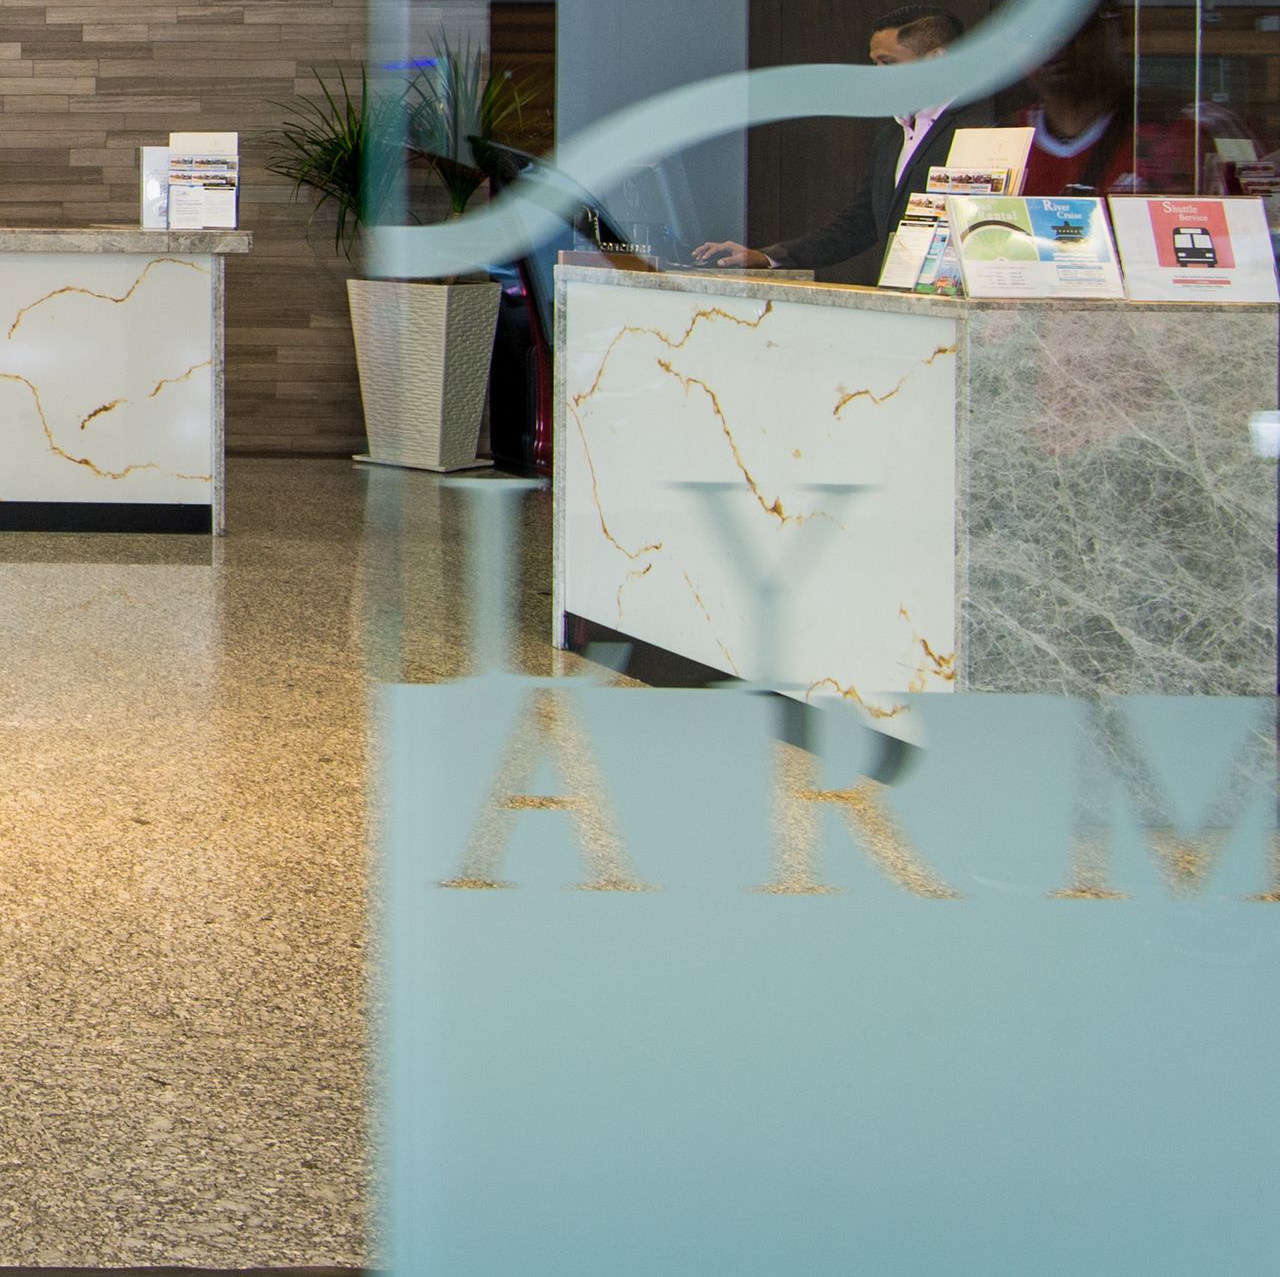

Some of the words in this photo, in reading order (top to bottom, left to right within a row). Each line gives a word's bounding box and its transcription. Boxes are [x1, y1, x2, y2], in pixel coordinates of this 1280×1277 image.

[1042, 199, 1071, 212] River
[1162, 201, 1198, 214] Shuttle
[1056, 211, 1083, 220] Cruise
[1178, 213, 1209, 222] Service
